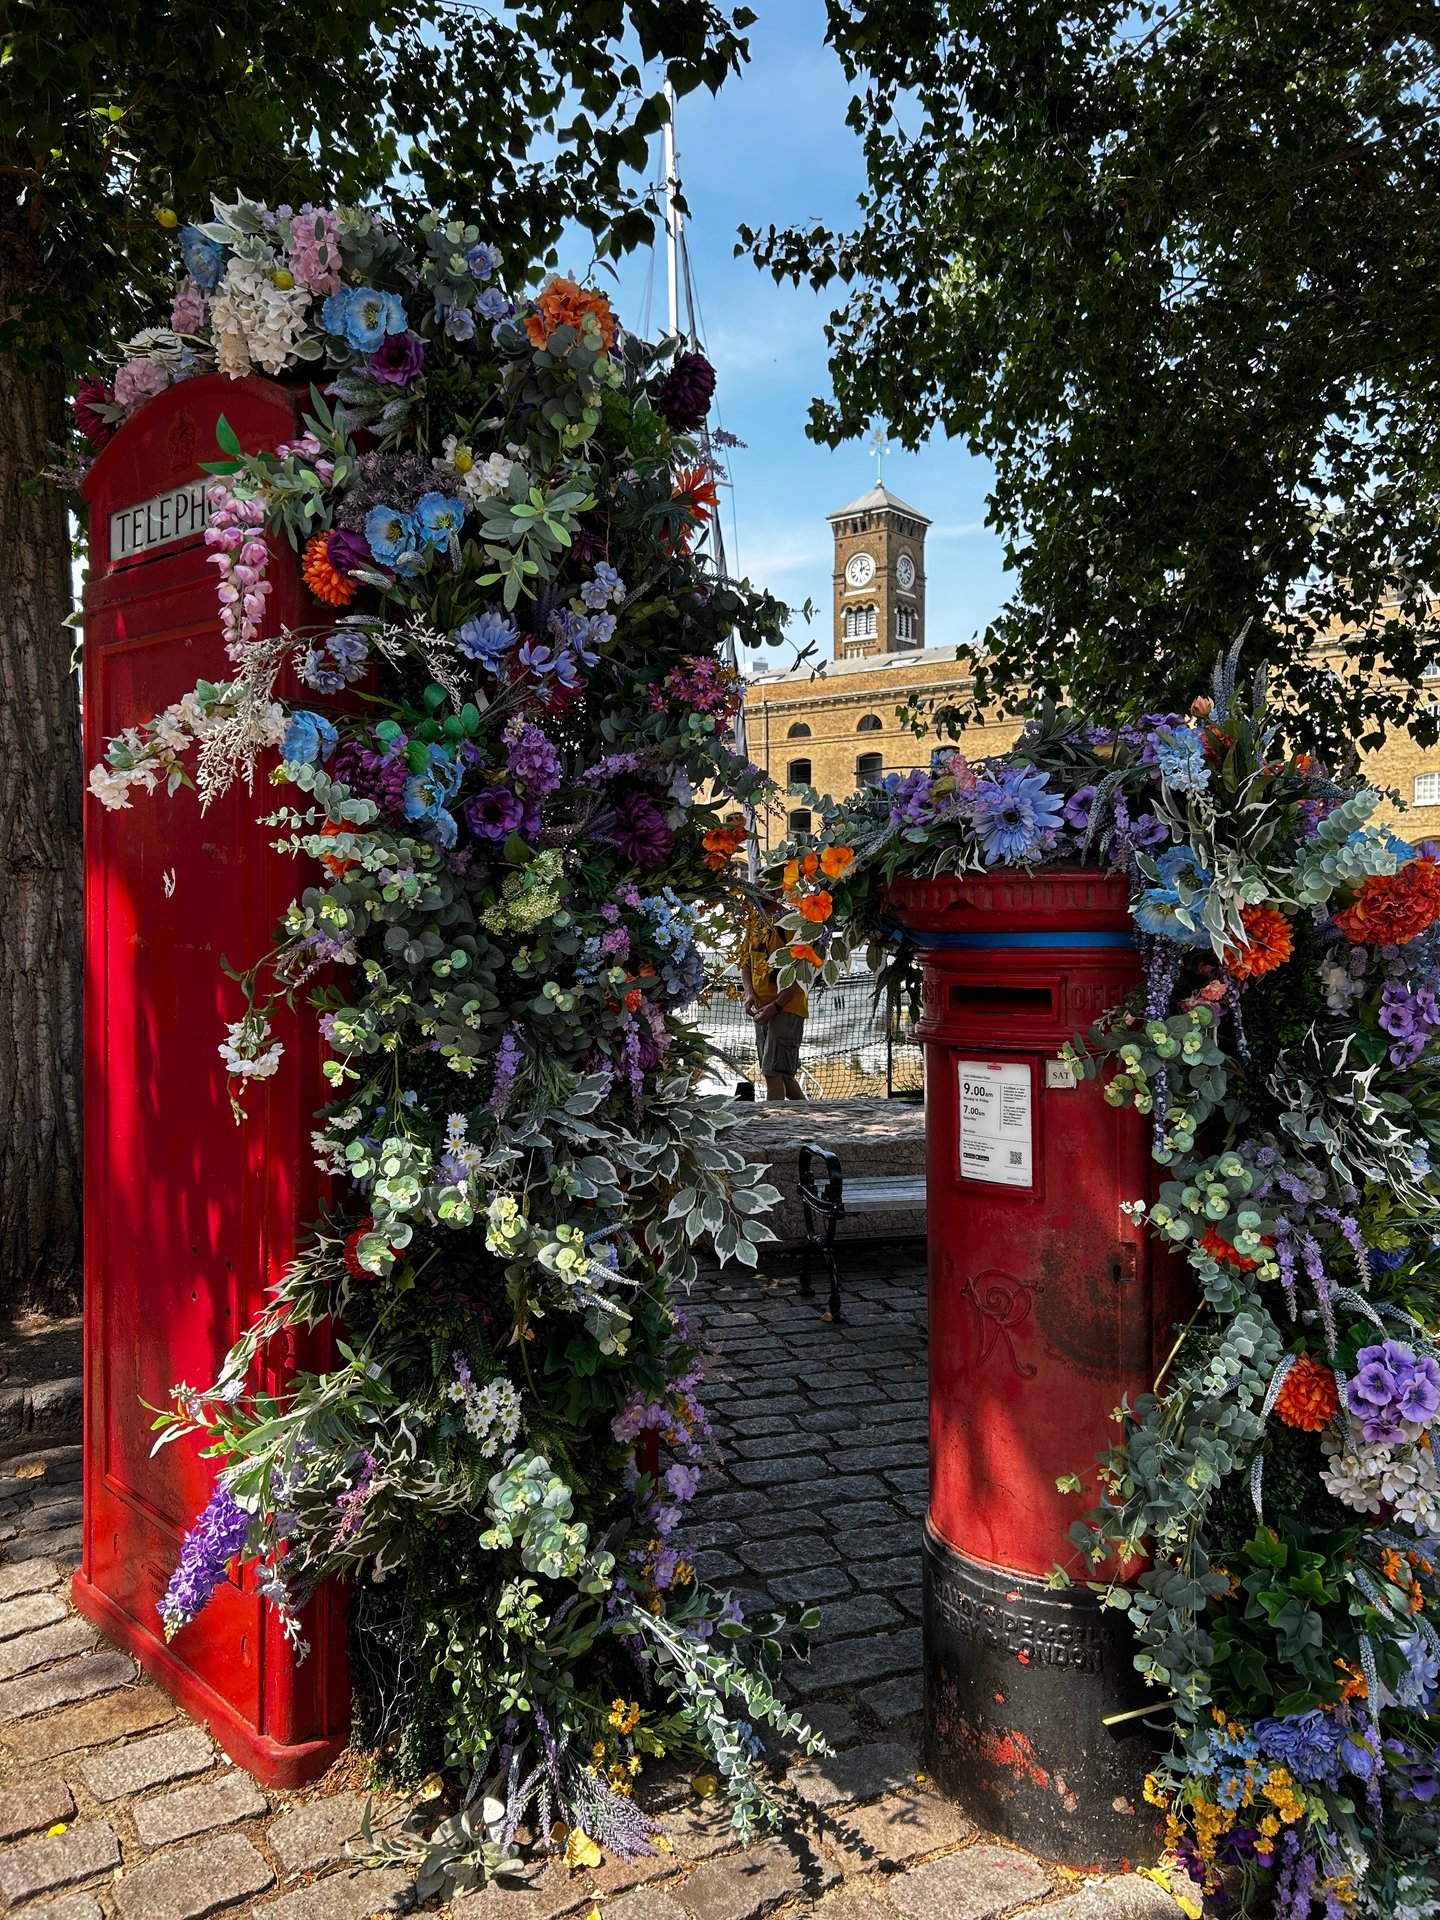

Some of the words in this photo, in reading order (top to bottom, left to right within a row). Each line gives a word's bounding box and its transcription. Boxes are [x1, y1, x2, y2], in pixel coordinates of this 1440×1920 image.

[117, 485, 220, 553] TELEPH
[1052, 1072, 1070, 1080] SAT
[999, 1634, 1104, 1672] LONDON
